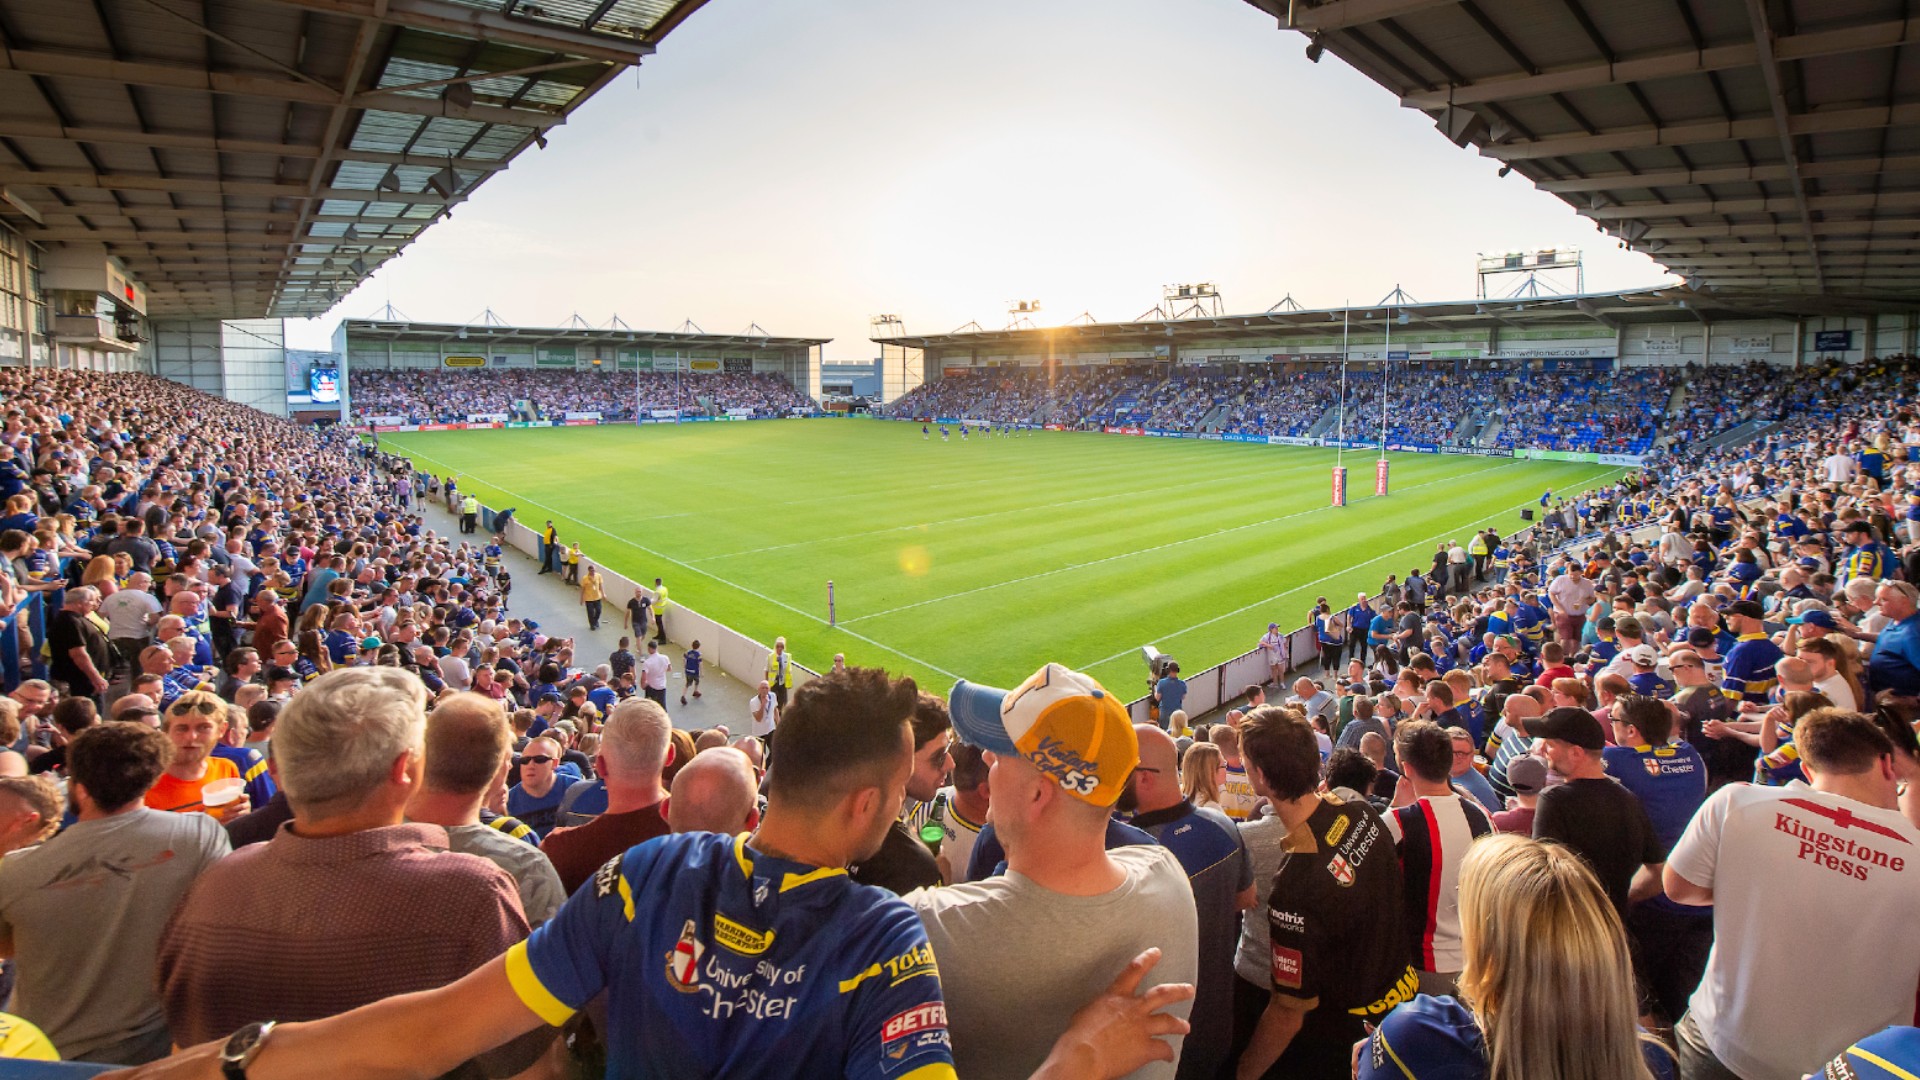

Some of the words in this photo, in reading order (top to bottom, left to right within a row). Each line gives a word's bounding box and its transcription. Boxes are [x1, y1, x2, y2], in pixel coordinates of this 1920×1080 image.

[627, 355, 652, 364] intgro
[1038, 736, 1098, 774] Vintage
[1661, 764, 1695, 774] Chester
[1060, 770, 1100, 796] 53
[1339, 817, 1368, 855] University
[1349, 821, 1380, 867] Chester
[1774, 812, 1905, 872] Kingstone
[1797, 841, 1869, 881] Press
[705, 953, 782, 988] Univesity
[784, 964, 806, 985] of
[883, 942, 938, 977] Total
[886, 1006, 948, 1038] BETFR
